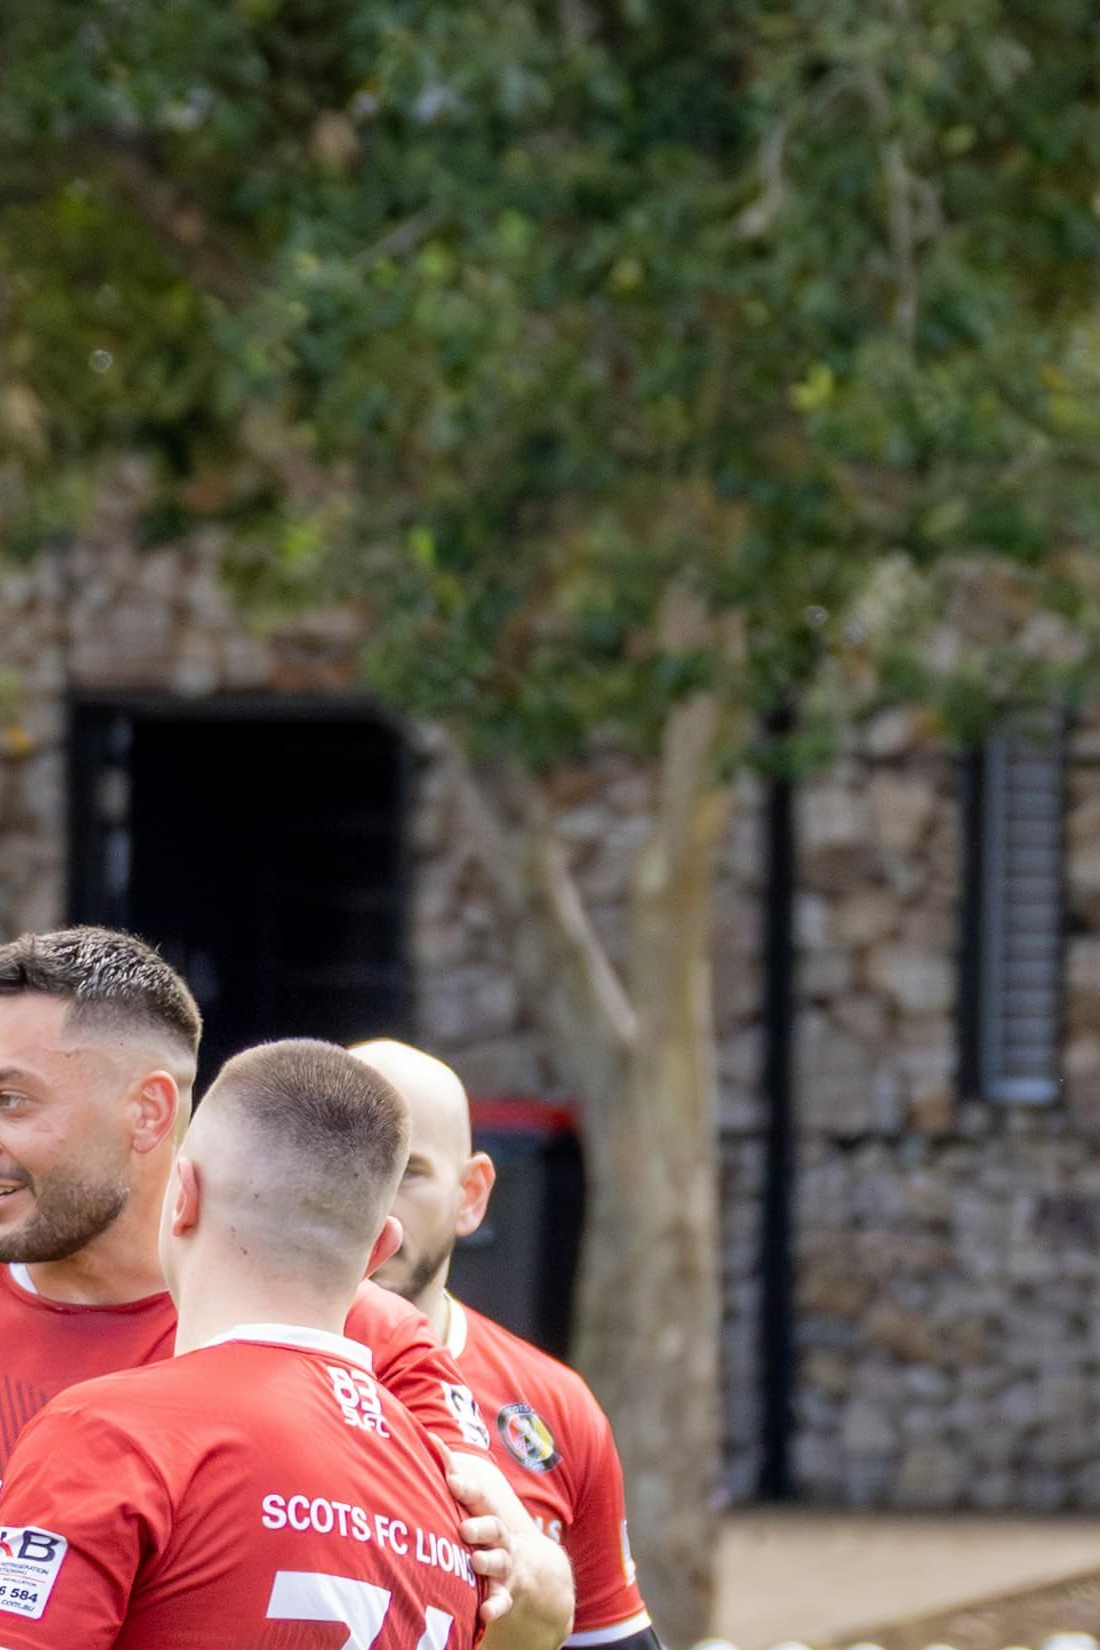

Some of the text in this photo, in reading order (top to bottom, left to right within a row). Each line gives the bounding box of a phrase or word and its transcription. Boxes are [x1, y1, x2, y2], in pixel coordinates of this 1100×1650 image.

[326, 1366, 382, 1415] 83
[261, 1494, 372, 1542] SCOTS
[373, 1519, 409, 1557] FC
[9, 1588, 39, 1603] 584
